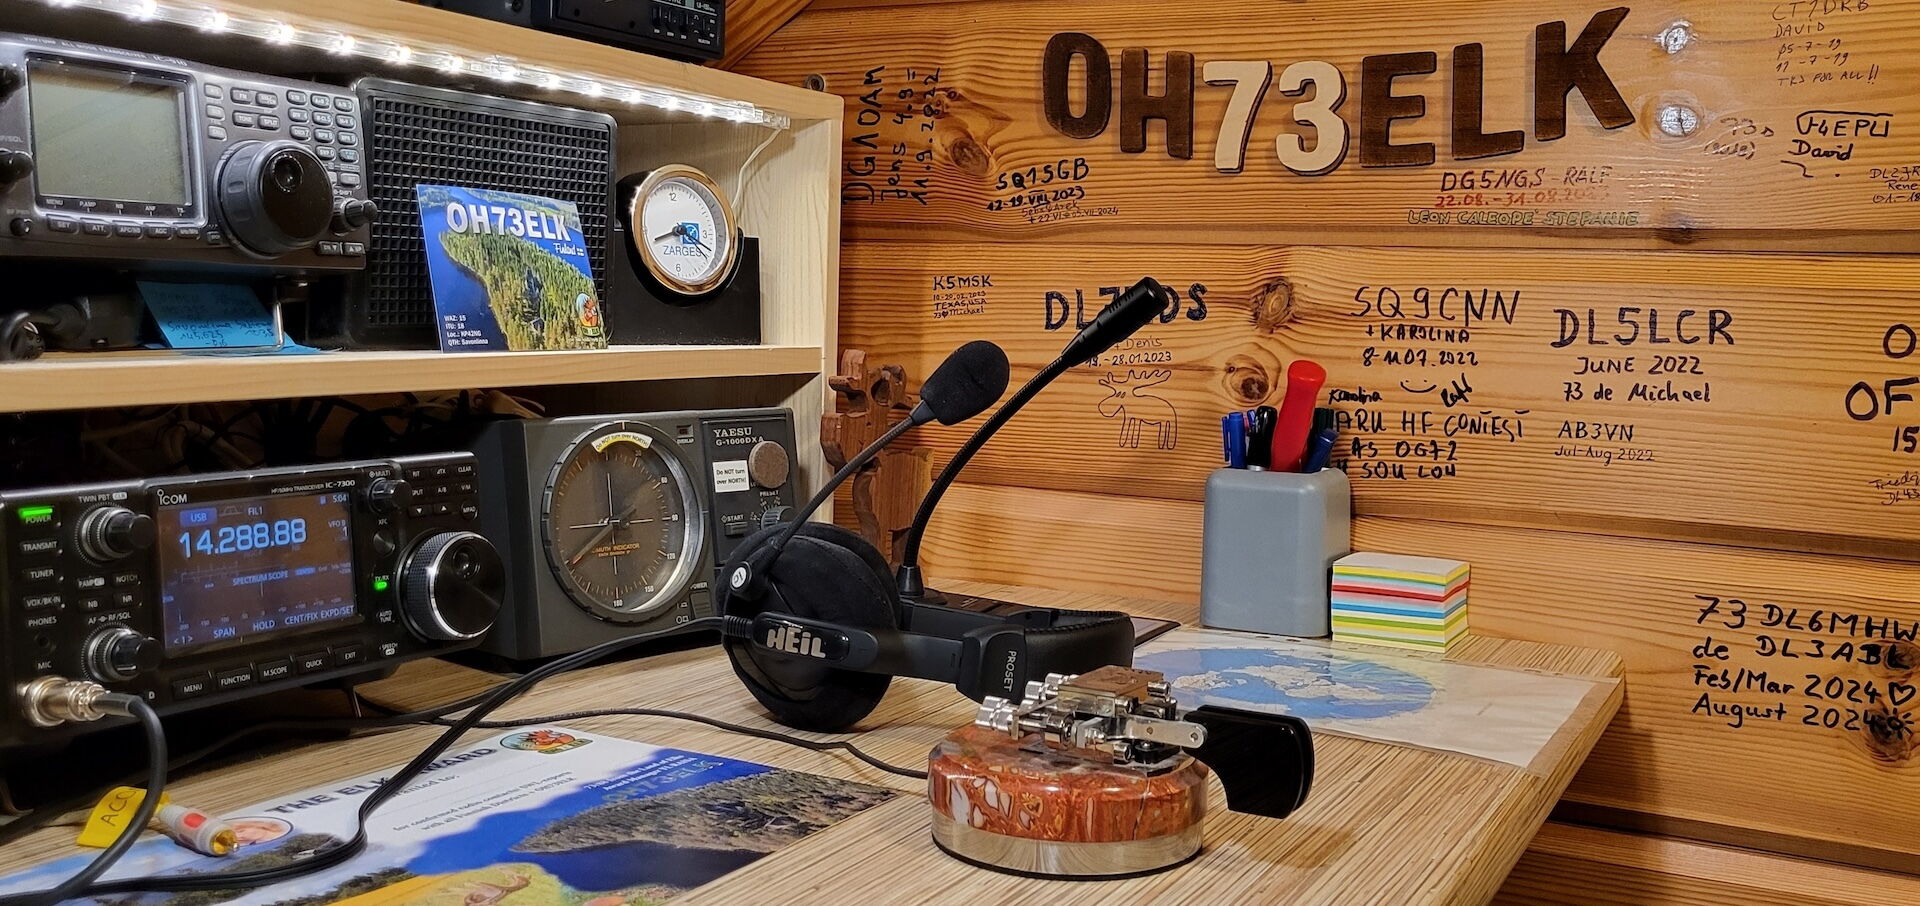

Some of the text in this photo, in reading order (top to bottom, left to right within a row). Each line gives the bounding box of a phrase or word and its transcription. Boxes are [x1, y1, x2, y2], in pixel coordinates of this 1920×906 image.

[1042, 6, 1637, 175] OH73ELK
[1787, 139, 1853, 161] David
[880, 142, 907, 202] Jens
[669, 193, 677, 201] 12
[446, 202, 572, 242] OH73ELK
[702, 230, 708, 239] 3
[663, 245, 702, 257] ZARGES
[675, 264, 681, 272] 6
[933, 274, 993, 290] K5MSK
[950, 306, 984, 316] Michael
[1045, 282, 1208, 331] DL7DS
[1350, 286, 1521, 327] SQ9CNN
[1380, 323, 1470, 343] KAROLINA
[1550, 307, 1735, 348] DL5LCR
[1122, 335, 1163, 350] Denis
[1648, 355, 1704, 375] 2022
[1563, 381, 1712, 402] 73 de Michael
[1401, 410, 1433, 436] HF
[713, 427, 752, 438] YAESU
[1557, 421, 1635, 442] AB3VN
[1617, 449, 1656, 462] 2022
[325, 480, 355, 489] IC-7300
[190, 512, 207, 522] USB
[671, 514, 679, 522] 90
[178, 518, 307, 558] 14.288.88
[23, 541, 57, 551] TRANSMIT
[30, 569, 54, 578] TUNER
[116, 574, 138, 583] NOTCH
[233, 573, 268, 586] SPECTRUM
[268, 570, 289, 581] SCOPE
[26, 596, 61, 607] VOX/BK-IN
[88, 600, 98, 608] NB
[122, 594, 133, 603] NR
[28, 617, 57, 627] PHONES
[88, 612, 131, 625] AF RF/SQL
[284, 605, 354, 625] CENT/FIX EXPD/SET
[1694, 594, 1920, 642] 73 DL6MHW
[213, 619, 275, 639] SPAN HOLD
[345, 651, 356, 660] EXIT
[1692, 636, 1730, 661] de
[38, 661, 51, 670] MIC
[305, 659, 322, 669] QUICK
[263, 666, 288, 677] M.SCOPE
[1001, 650, 1017, 693] PROSET
[221, 674, 251, 686] FUNCTION
[184, 683, 203, 694] MENU
[1804, 674, 1881, 704] 2024
[1692, 692, 1787, 729] August
[265, 793, 339, 814] THE
[421, 748, 498, 774] WARD
